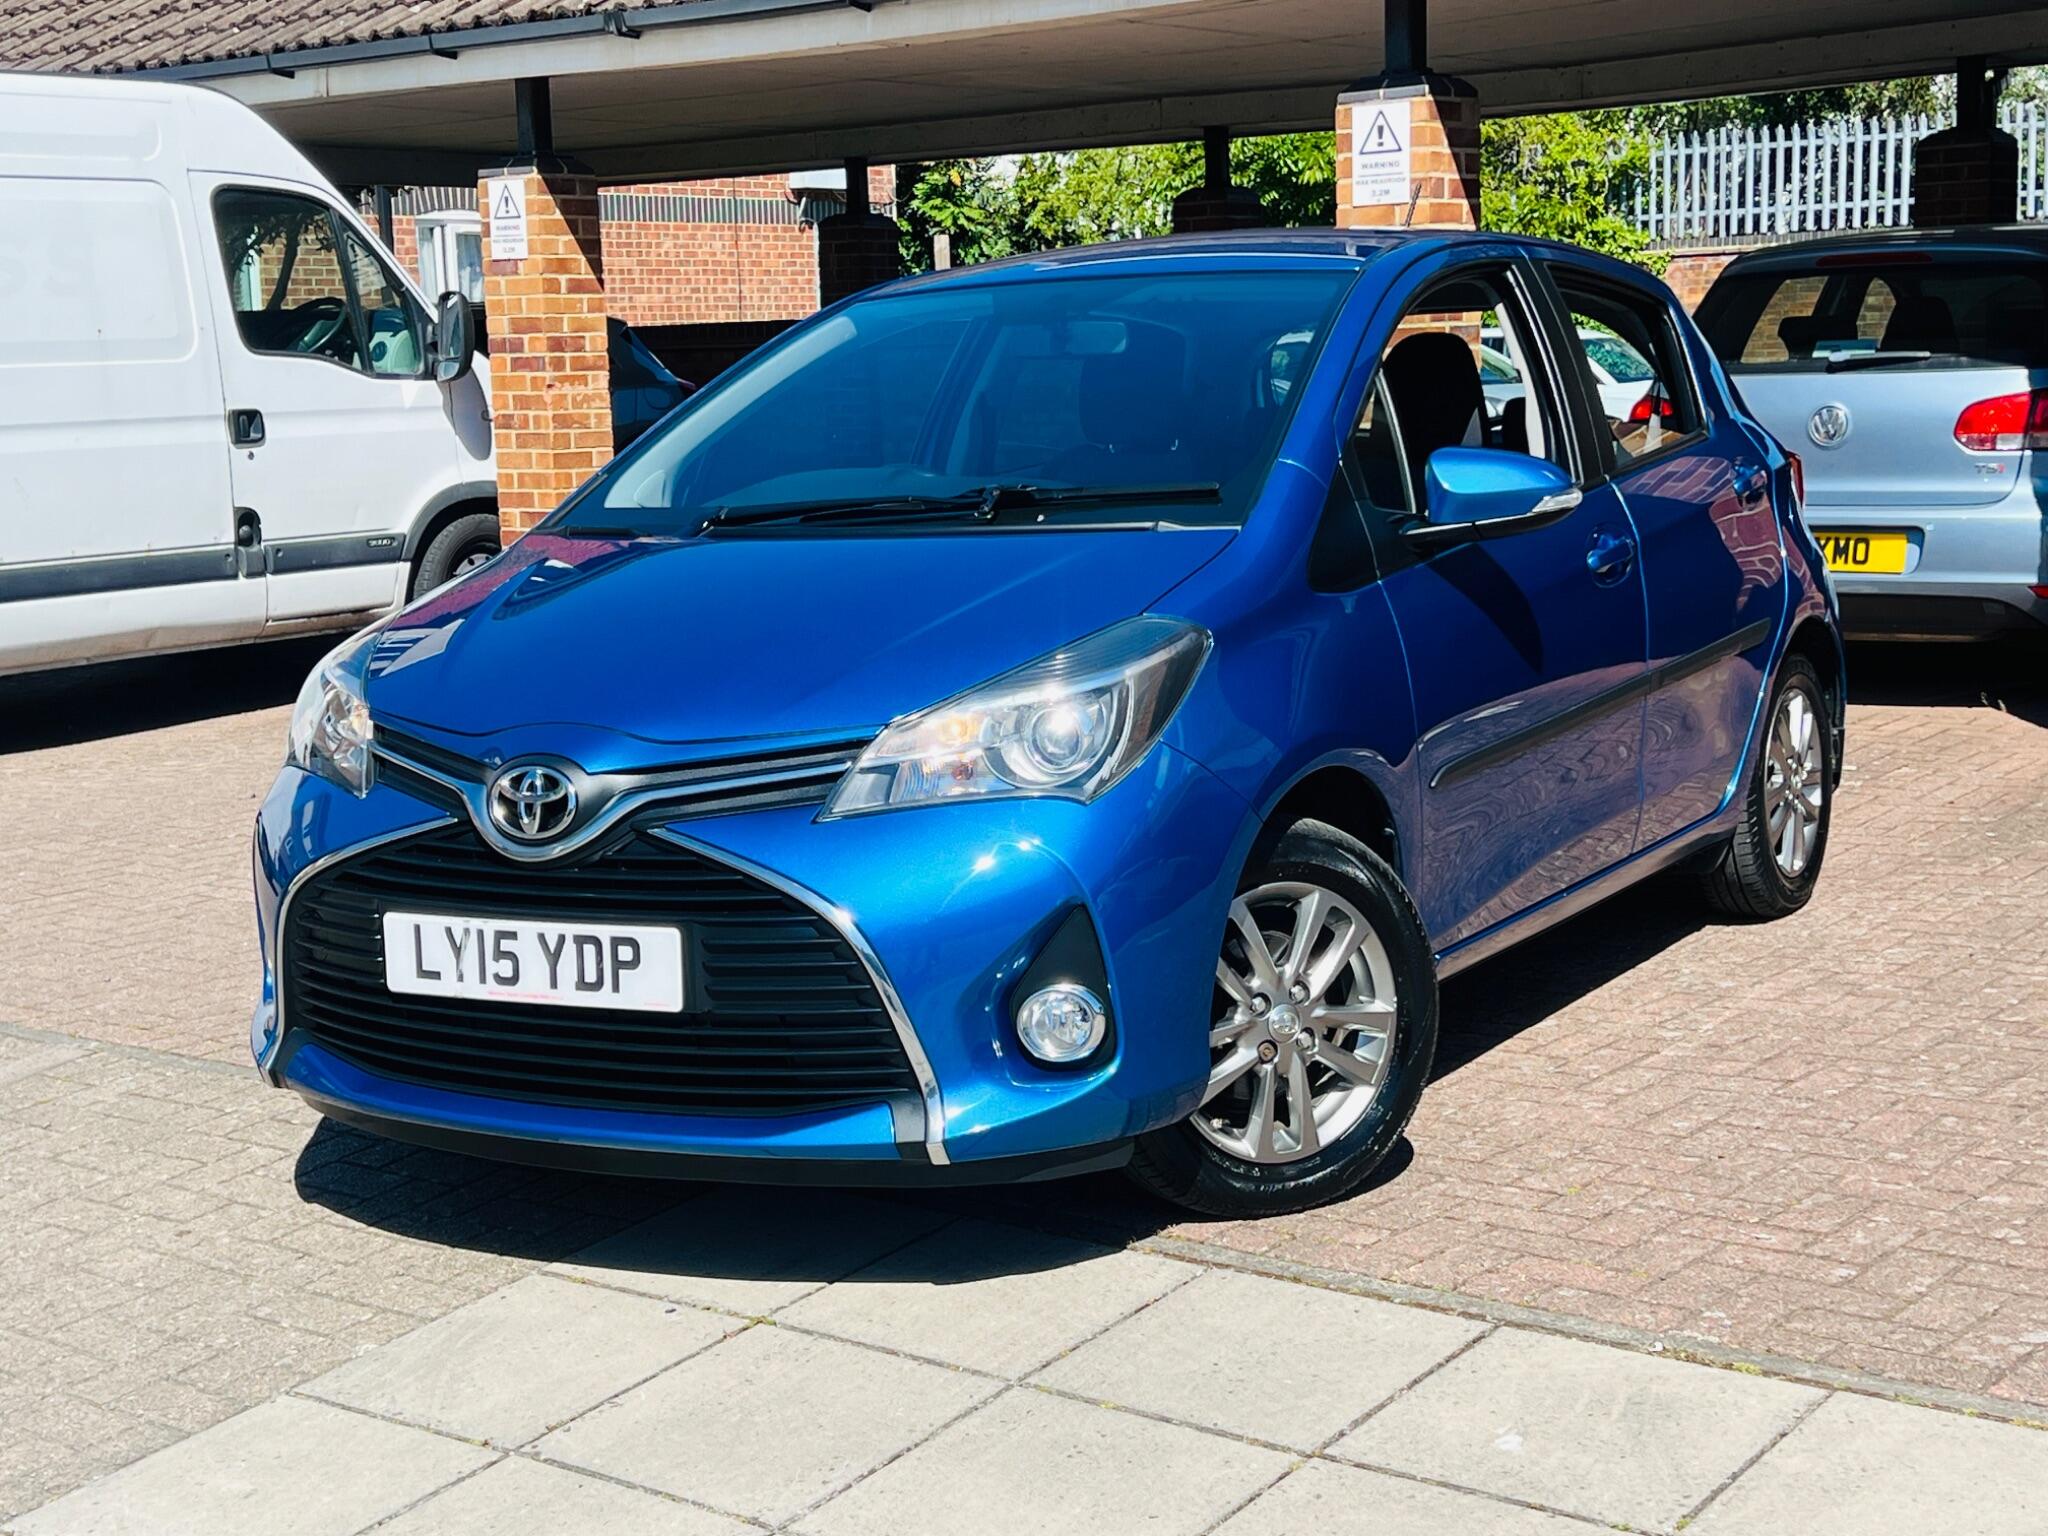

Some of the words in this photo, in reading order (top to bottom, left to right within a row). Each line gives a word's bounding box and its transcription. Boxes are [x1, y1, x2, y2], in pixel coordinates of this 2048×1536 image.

[1361, 160, 1400, 170] WARNING
[413, 923, 520, 987] LY15
[536, 932, 641, 993] YDP
